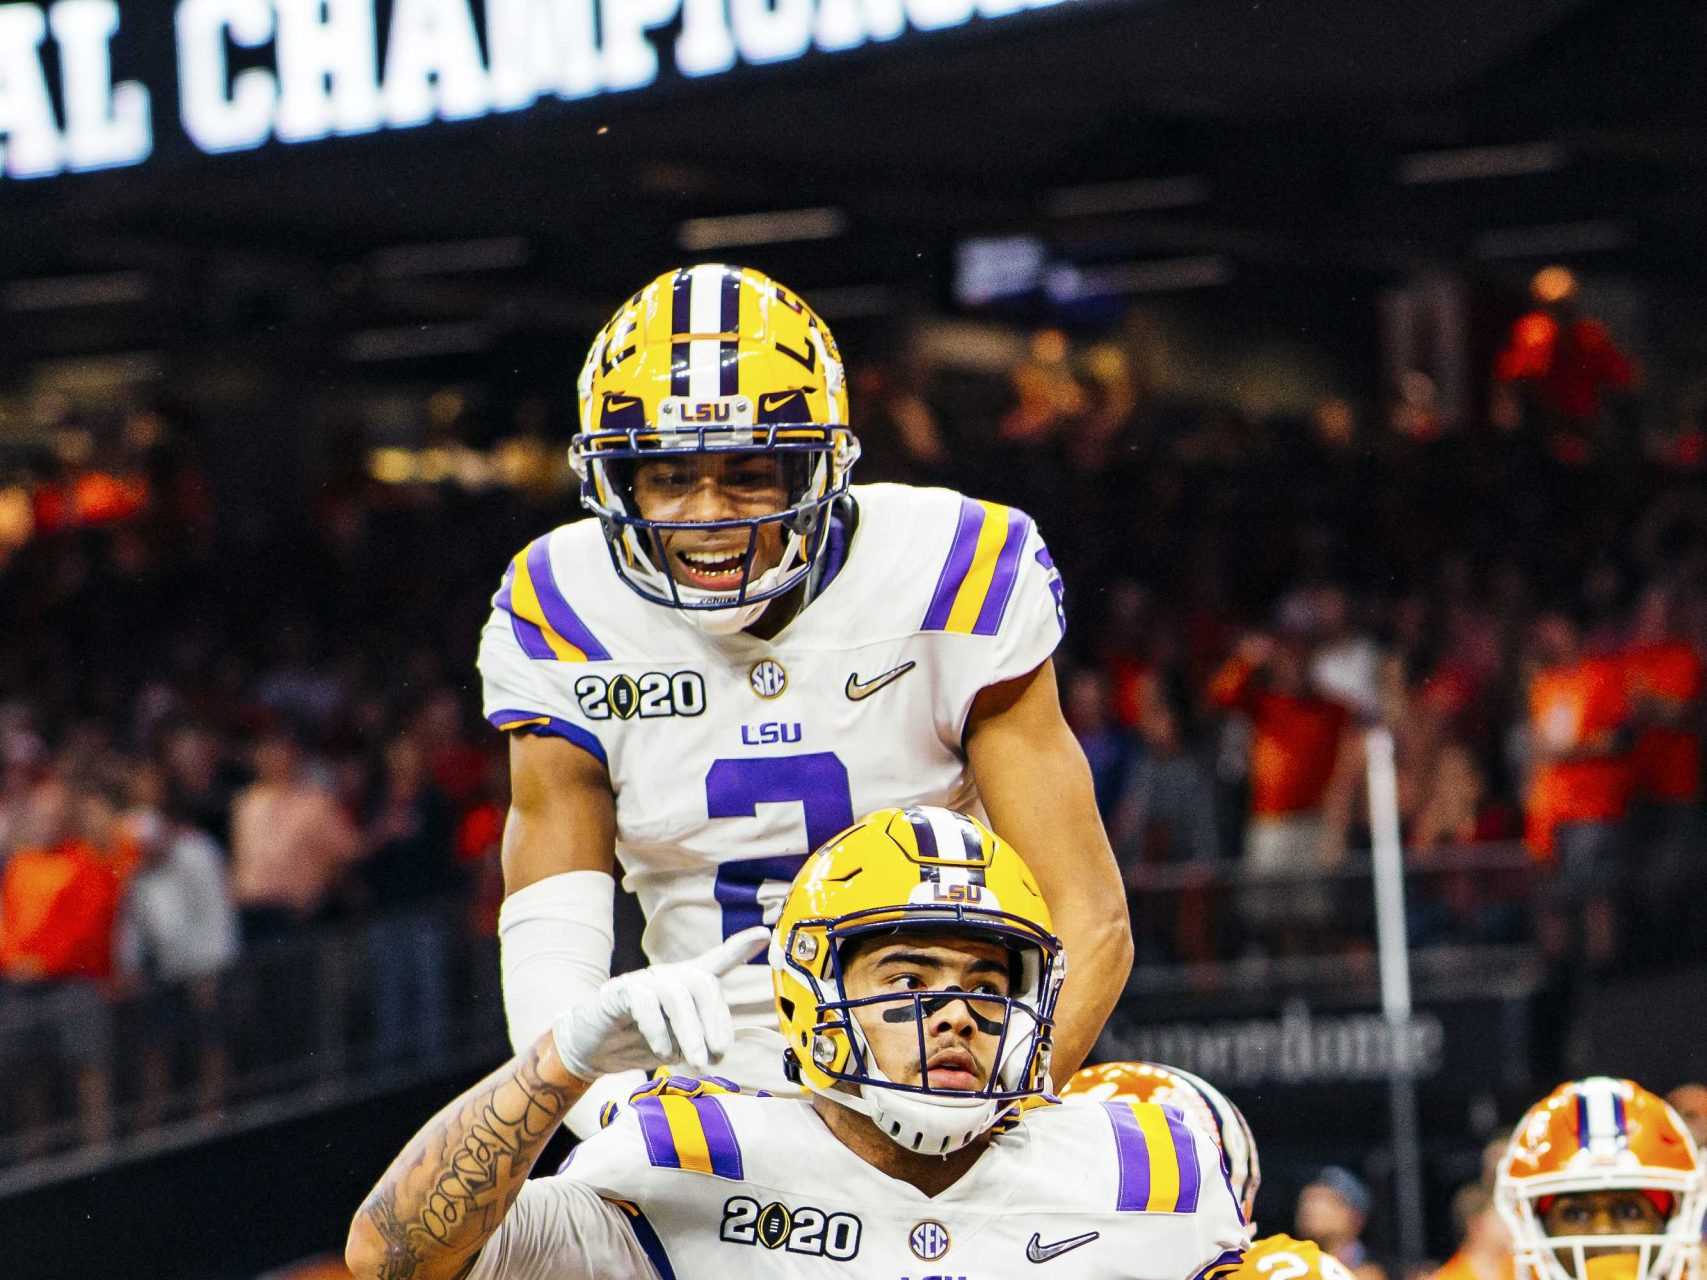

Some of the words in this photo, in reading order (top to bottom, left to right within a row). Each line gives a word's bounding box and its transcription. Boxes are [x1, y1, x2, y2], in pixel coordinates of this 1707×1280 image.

[680, 402, 731, 422] LSU
[750, 659, 788, 698] SEC
[740, 722, 802, 746] LSU
[933, 883, 983, 905] LSU
[909, 1220, 951, 1261] SEC
